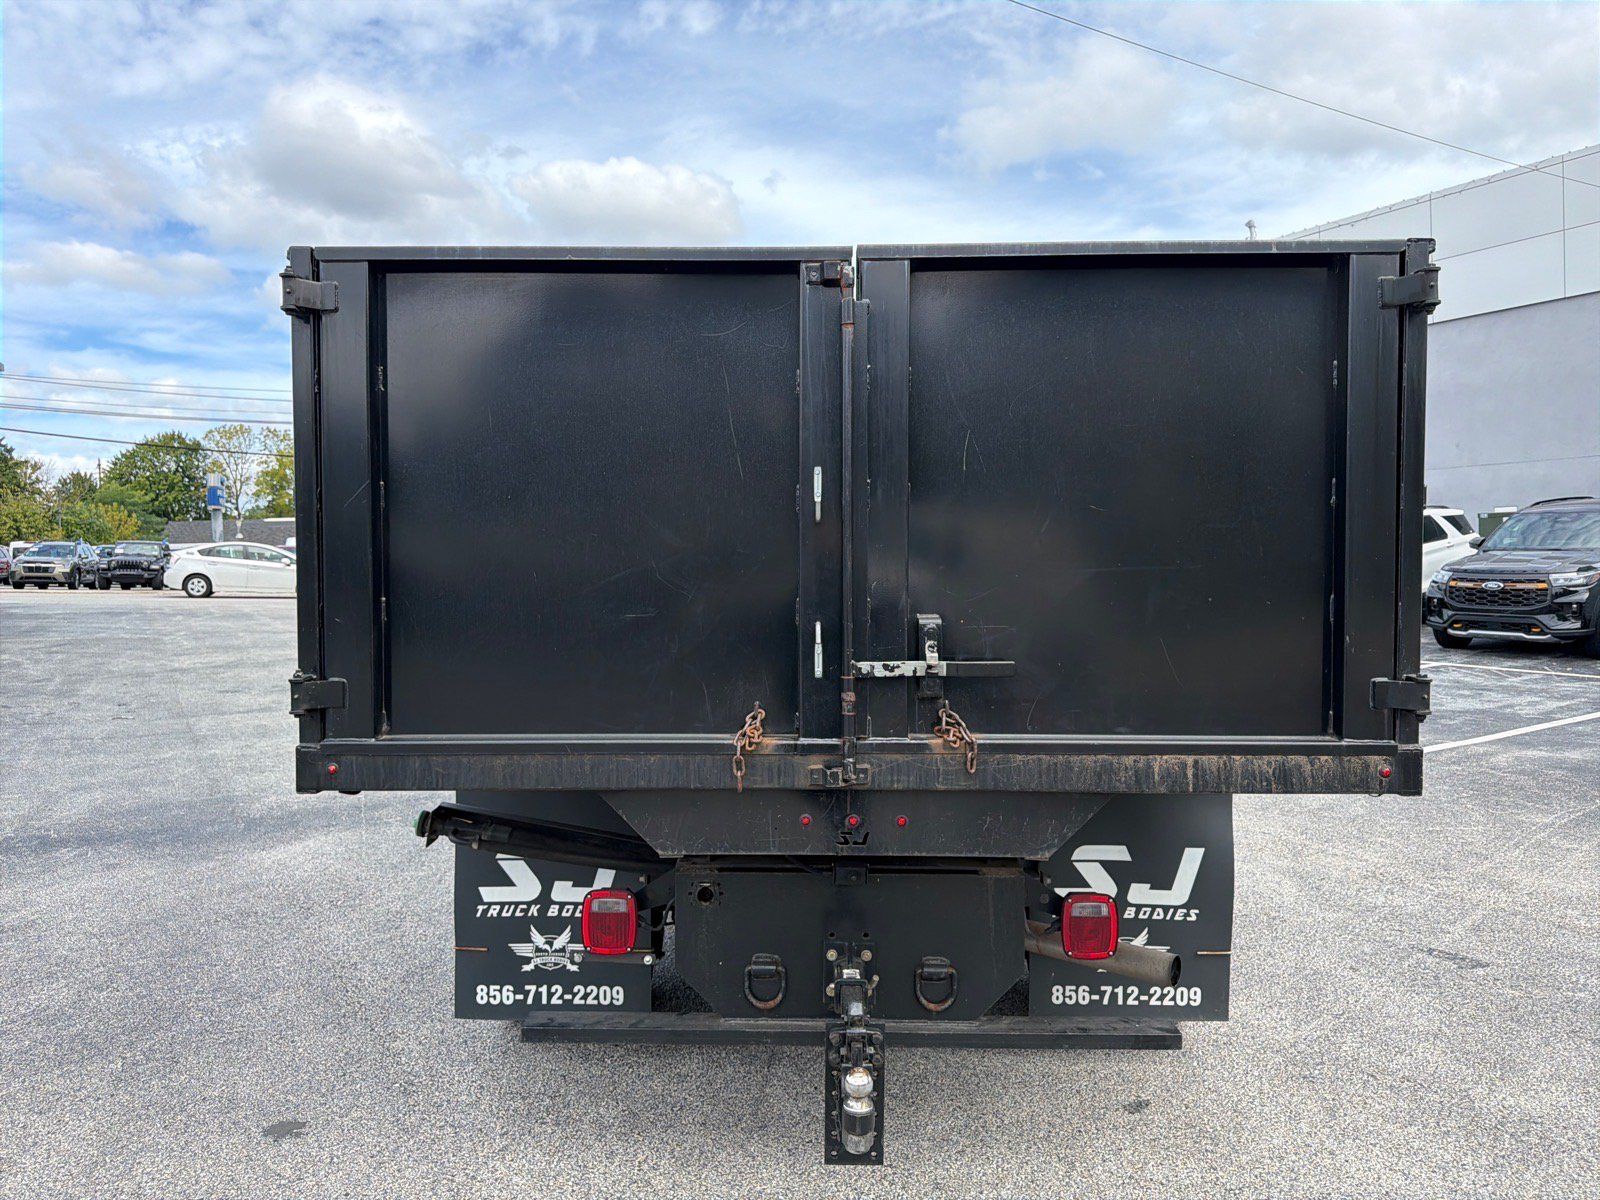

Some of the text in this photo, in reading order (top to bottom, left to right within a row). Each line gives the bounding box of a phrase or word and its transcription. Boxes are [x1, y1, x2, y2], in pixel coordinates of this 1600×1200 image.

[835, 831, 870, 846] SJ
[478, 853, 616, 902] SJ
[1054, 845, 1205, 906] SJ
[476, 905, 583, 917] TRUCK BOD
[1123, 907, 1200, 922] BODIES
[475, 985, 625, 1006] 856-712-2209
[1051, 985, 1202, 1007] 856-712-2209
